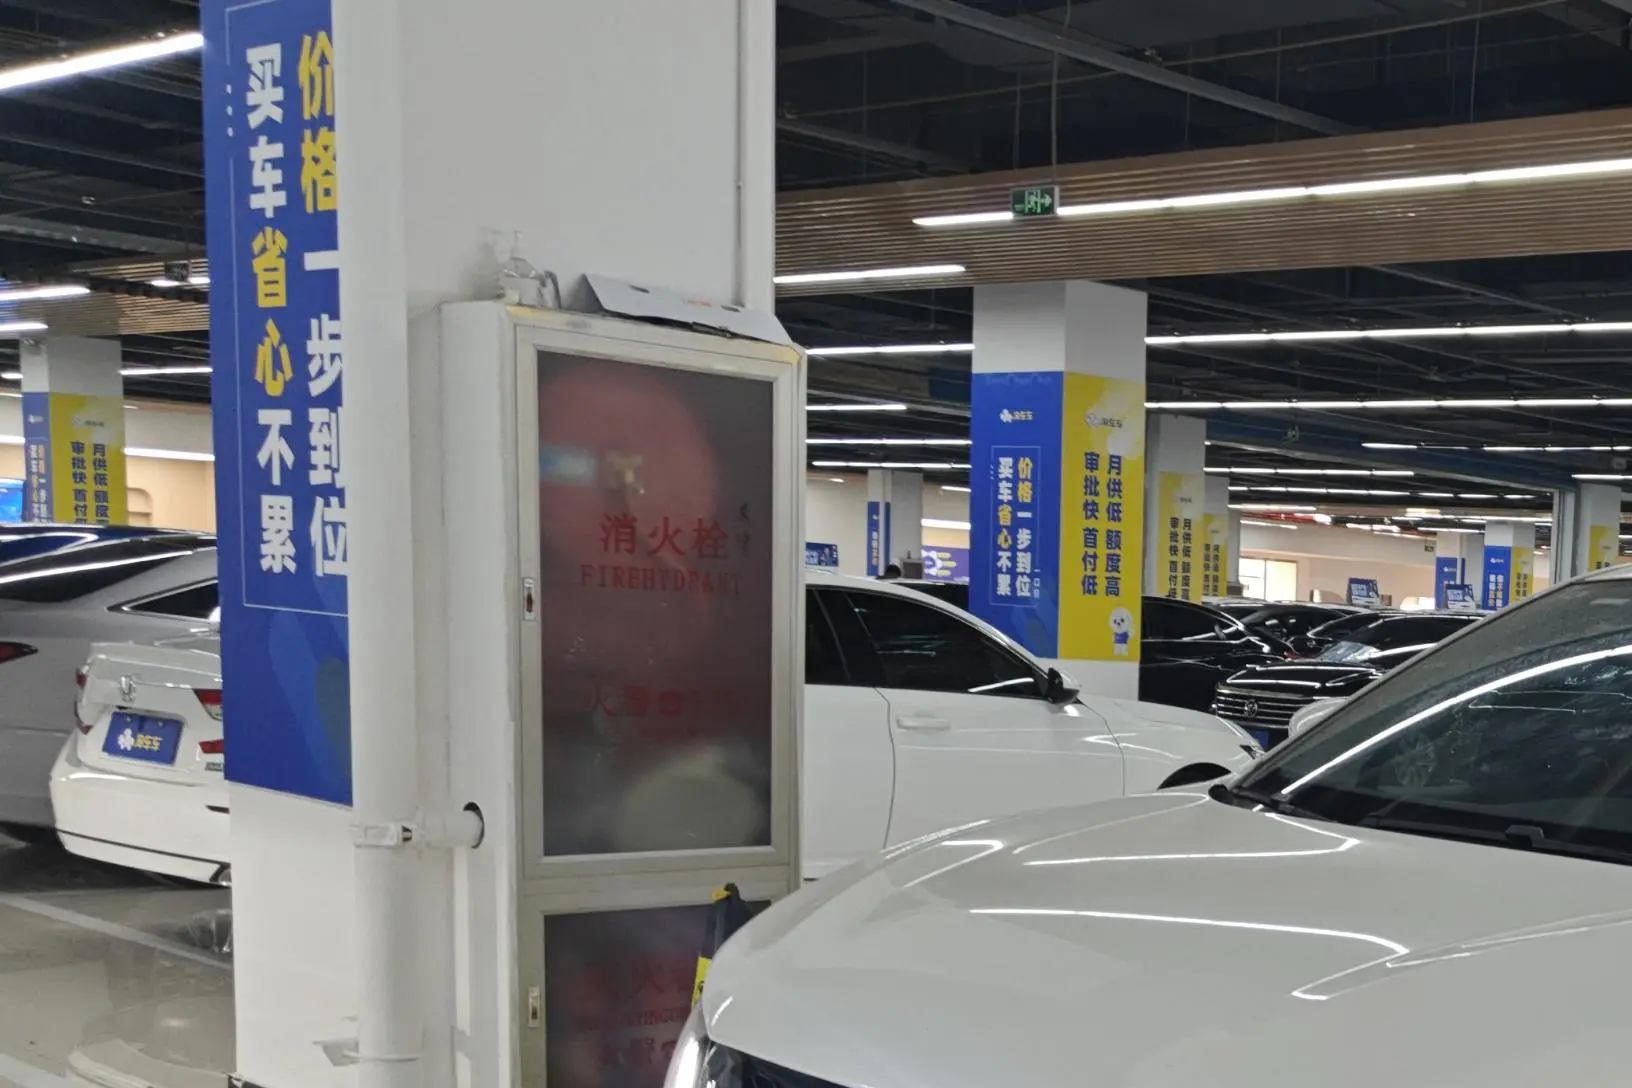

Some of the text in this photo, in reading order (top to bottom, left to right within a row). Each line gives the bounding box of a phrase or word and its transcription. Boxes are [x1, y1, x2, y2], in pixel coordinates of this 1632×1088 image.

[245, 43, 297, 574] 买车省心不累
[298, 31, 349, 577] 价格一步到位
[600, 512, 728, 560] 消火栓
[996, 456, 1014, 596] 买车省心不累
[1015, 456, 1033, 598] 价格一步到位
